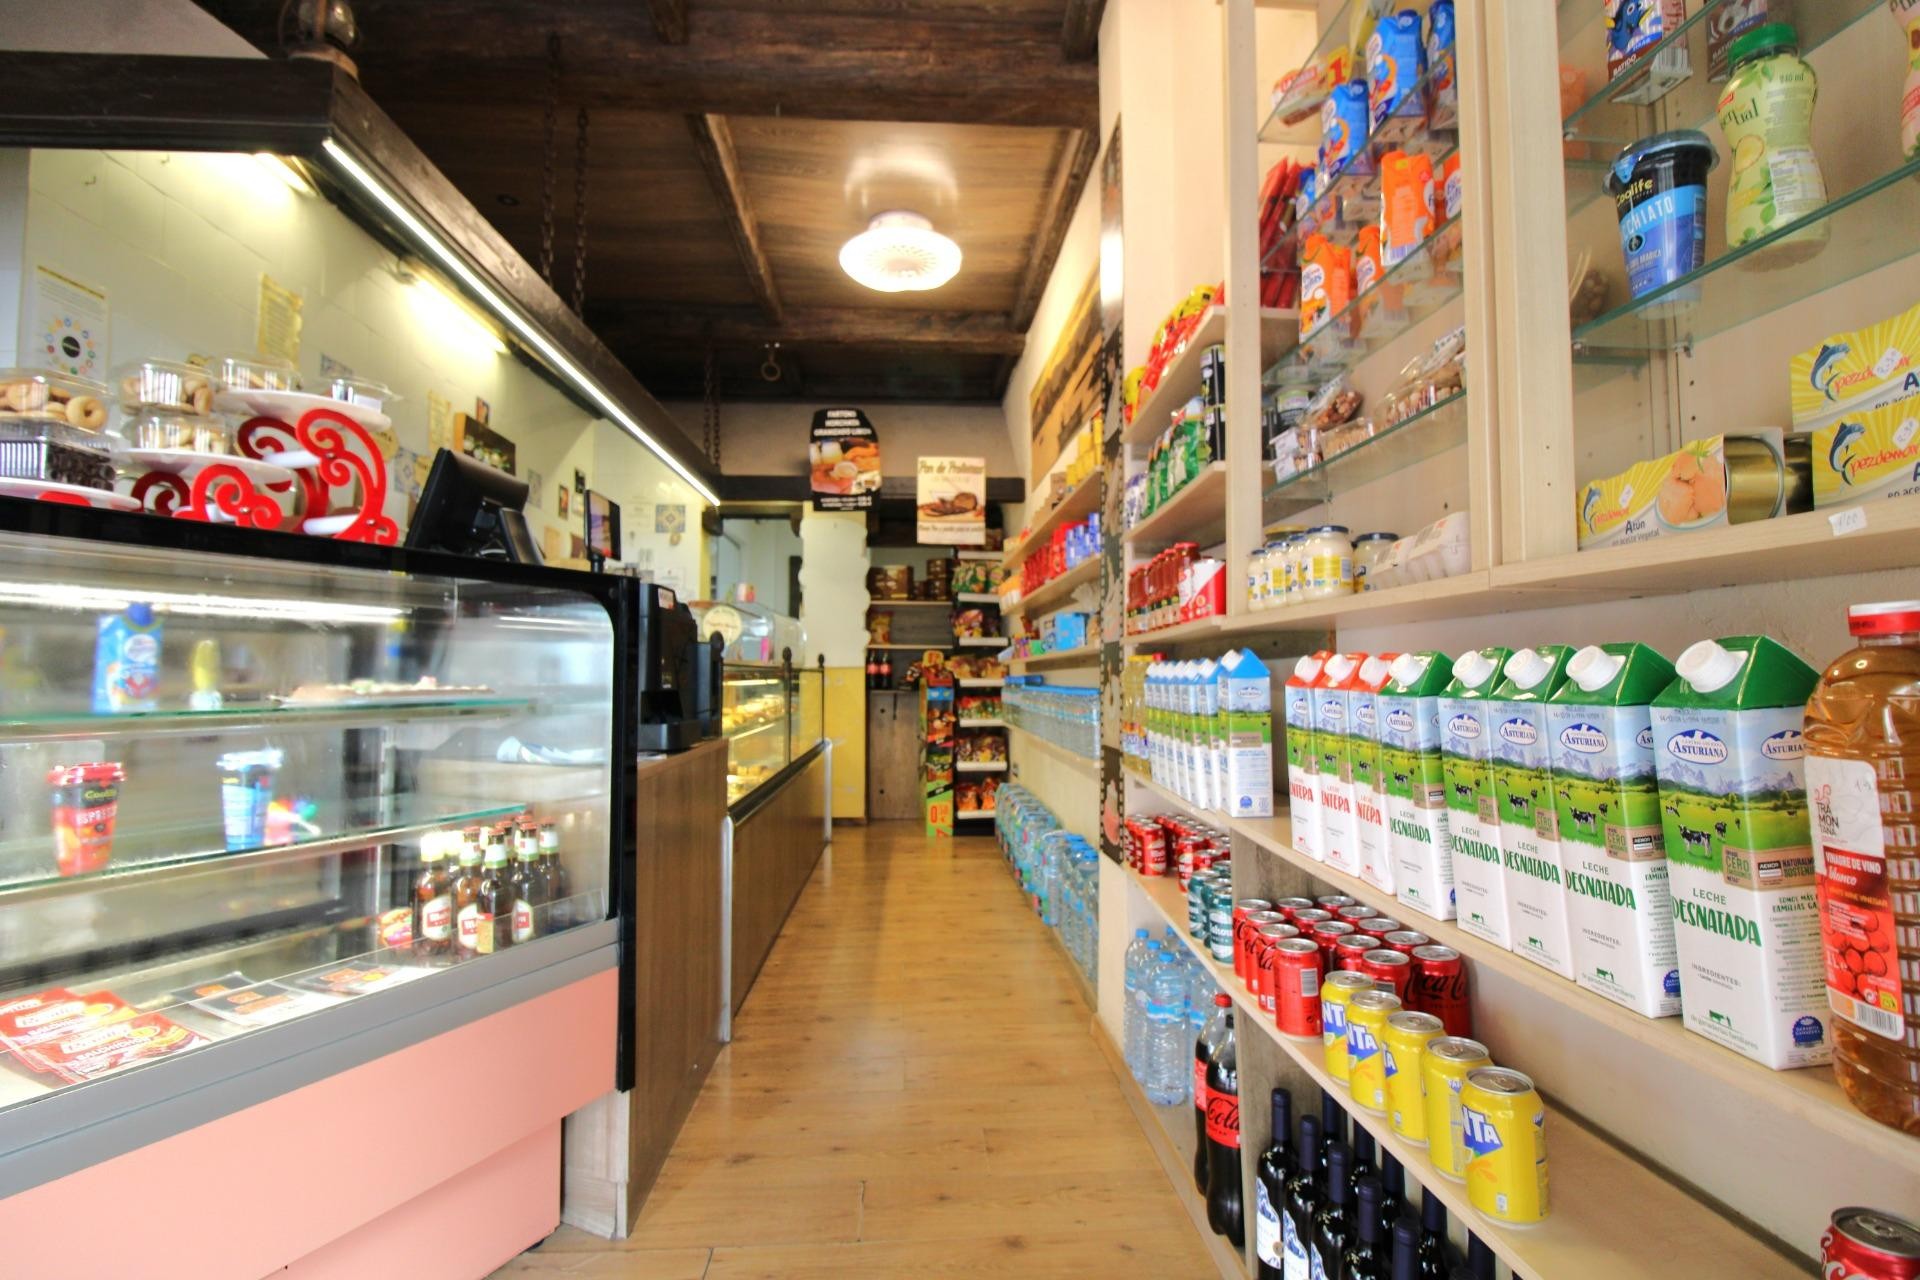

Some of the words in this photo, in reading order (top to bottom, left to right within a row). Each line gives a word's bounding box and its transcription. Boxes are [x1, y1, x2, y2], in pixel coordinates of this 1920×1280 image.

[1626, 520, 1646, 535] Atún
[1503, 727, 1536, 740] ASTURIANA
[1564, 733, 1605, 748] ASTURIANA
[1673, 740, 1724, 758] ASTURIANA
[1816, 802, 1832, 814] TRA
[1818, 815, 1839, 828] MON
[1462, 827, 1480, 838] LECHE
[1450, 834, 1500, 865] DESNATADA
[1518, 841, 1538, 854] LECHE
[1504, 849, 1561, 885] DESNATADA
[1583, 861, 1610, 876] LECHE
[1726, 855, 1749, 873] CERO
[1851, 859, 1861, 871] DE
[1862, 859, 1881, 874] VINO
[1828, 866, 1857, 886] blanco
[1565, 868, 1637, 911] DESNATADA
[1693, 887, 1727, 905] LECHE
[1672, 897, 1762, 947] DESNATADA
